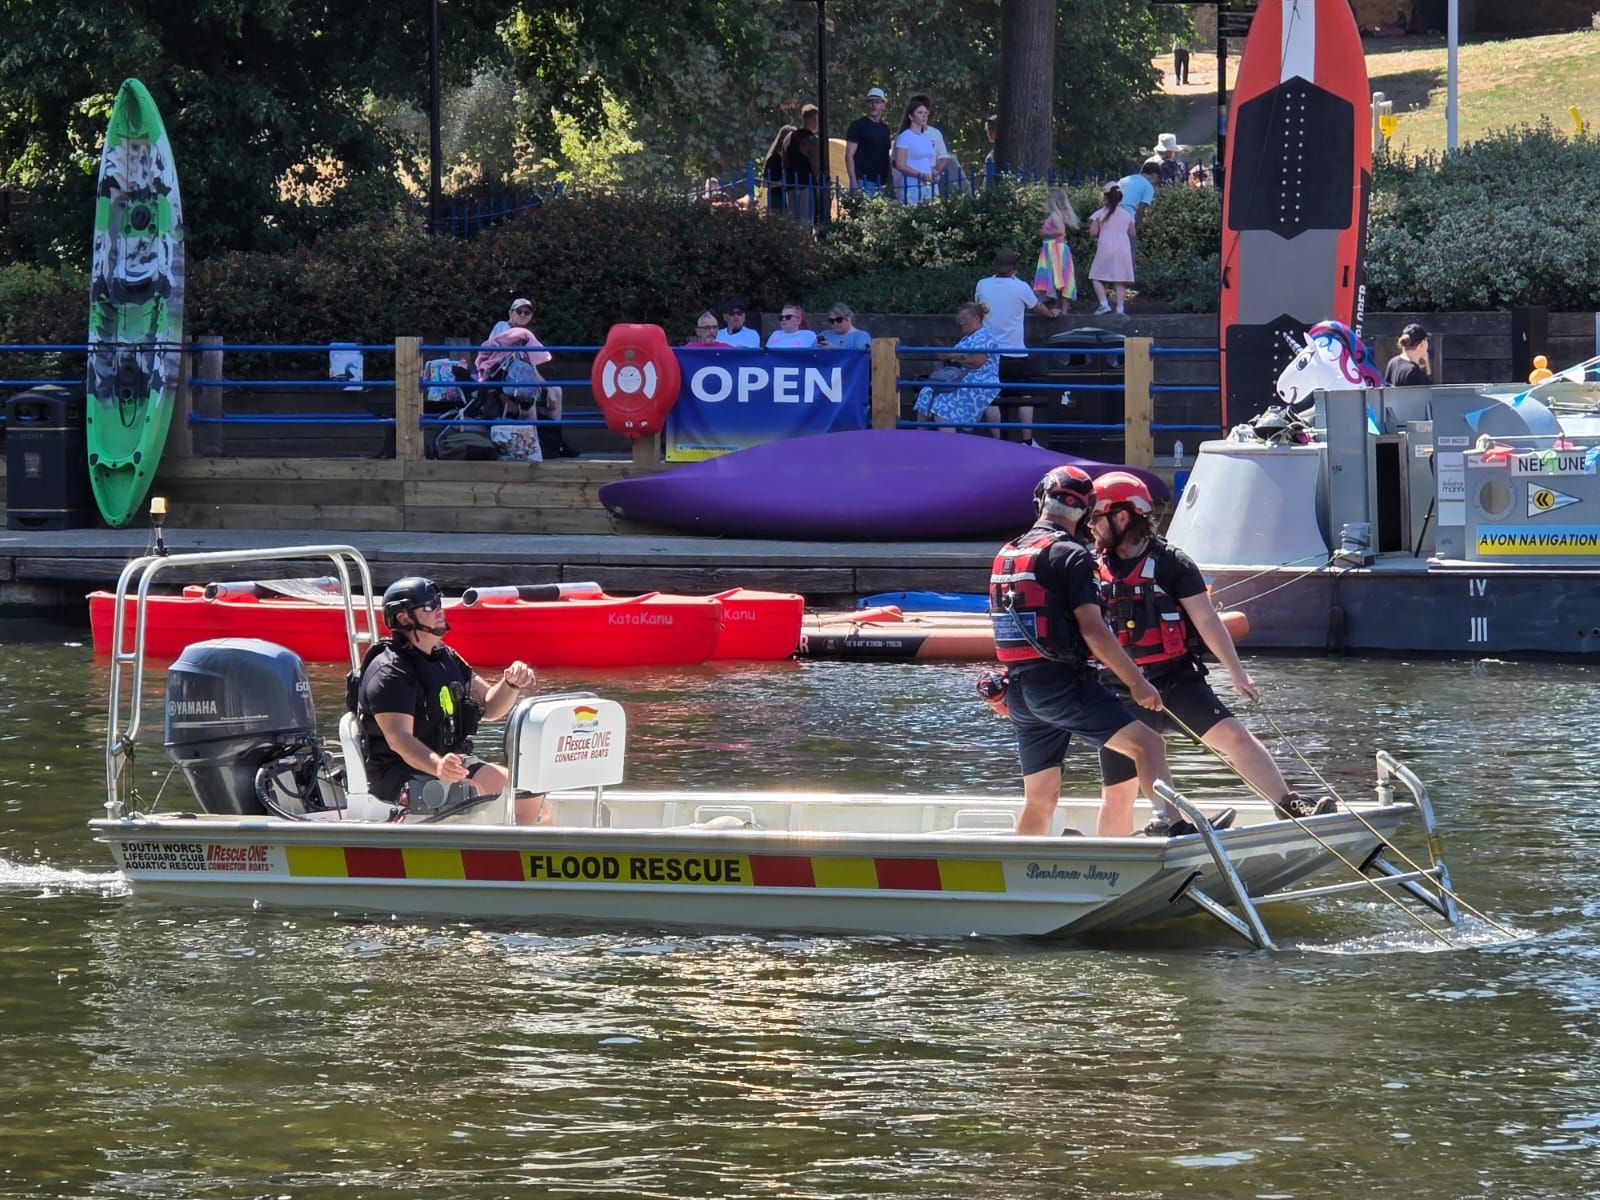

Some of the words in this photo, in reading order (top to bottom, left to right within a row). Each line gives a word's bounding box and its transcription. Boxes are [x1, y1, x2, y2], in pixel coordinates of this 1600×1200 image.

[691, 366, 842, 403] OPEN
[1480, 534, 1516, 546] AVON
[1519, 533, 1598, 546] NAVIGATION
[1469, 579, 1487, 596] IV
[608, 611, 673, 625] KataKanu
[177, 700, 217, 715] YAMAHA
[555, 751, 588, 763] CONNECTOR
[590, 749, 609, 759] BOATS
[121, 843, 160, 853] SOUTH
[162, 843, 203, 853] WORCS
[123, 852, 176, 862] LIFEGUARD
[179, 853, 204, 862] CLUB
[125, 861, 167, 870] AQUATIC
[170, 862, 206, 871] RESCUE
[208, 862, 246, 871] CONNECTOR
[248, 863, 269, 872] BOATS
[530, 856, 620, 879] FLOOD
[629, 857, 741, 882] RESCUE
[1026, 863, 1081, 880] Barbara
[1083, 864, 1120, 887] Mary
